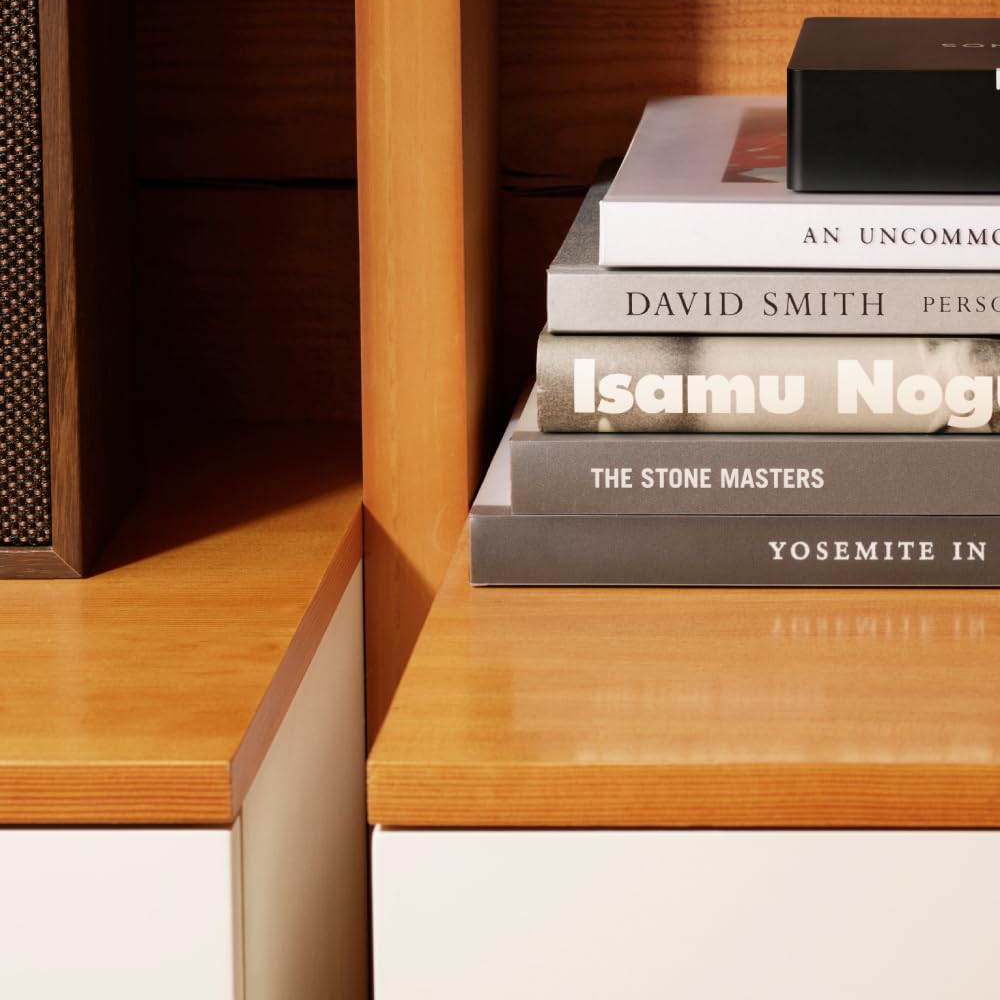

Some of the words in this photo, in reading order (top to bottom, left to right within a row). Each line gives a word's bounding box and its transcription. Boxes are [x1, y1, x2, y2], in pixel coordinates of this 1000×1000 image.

[803, 227, 840, 244] AN
[626, 291, 744, 316] DAVID
[762, 291, 885, 316] SMITH
[573, 358, 805, 415] Isamu
[591, 468, 633, 488] THE
[641, 468, 712, 489] STONE
[720, 468, 825, 489] MASTERS
[768, 541, 935, 561] YOSEMITE
[953, 541, 987, 561] IN
